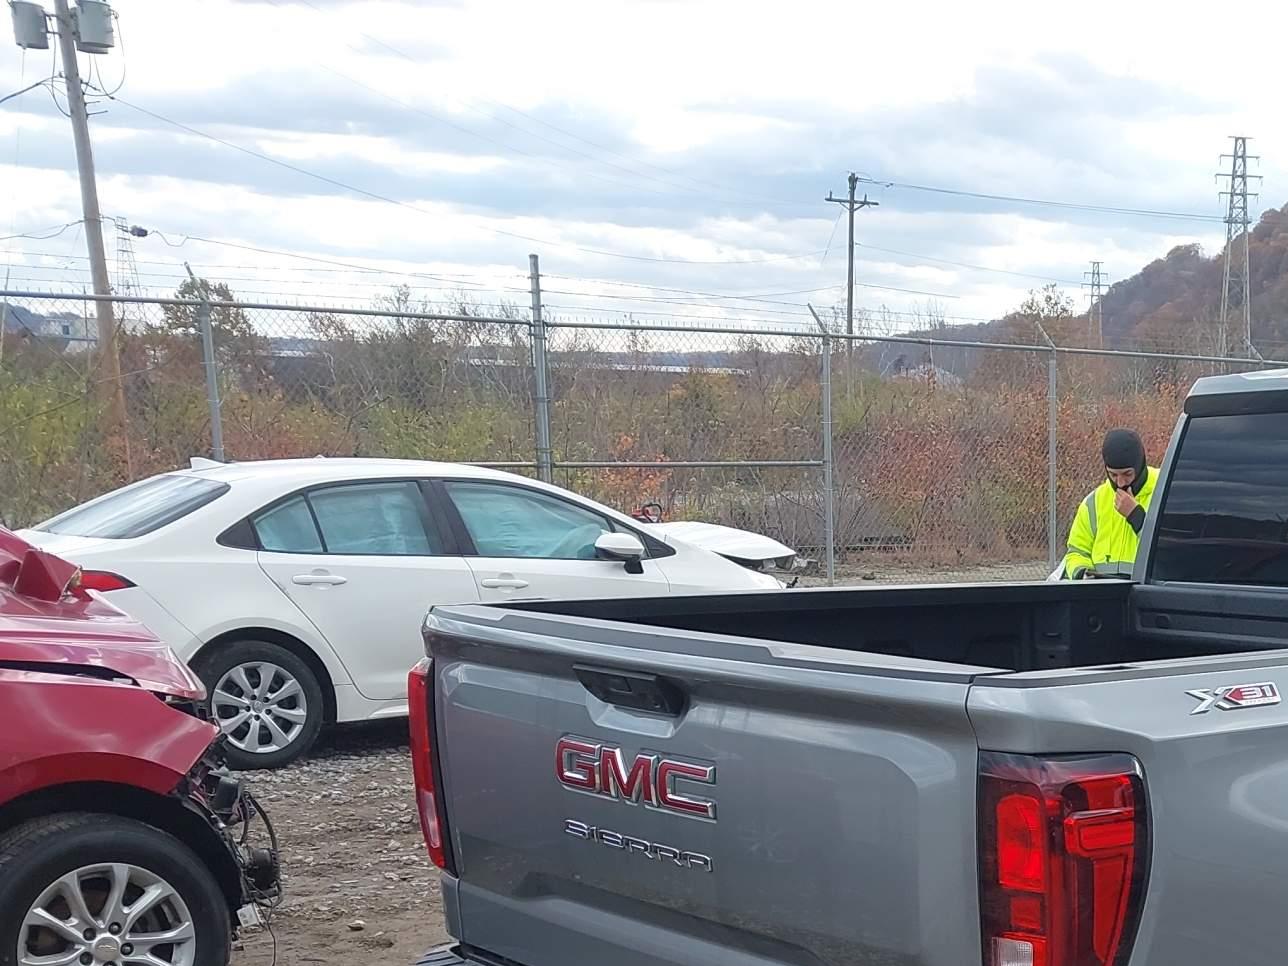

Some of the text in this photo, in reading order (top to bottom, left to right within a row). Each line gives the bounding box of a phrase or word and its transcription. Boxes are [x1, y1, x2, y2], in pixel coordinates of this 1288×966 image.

[1184, 682, 1282, 715] X31
[555, 735, 717, 822] GMC
[564, 819, 713, 872] SIERRA
